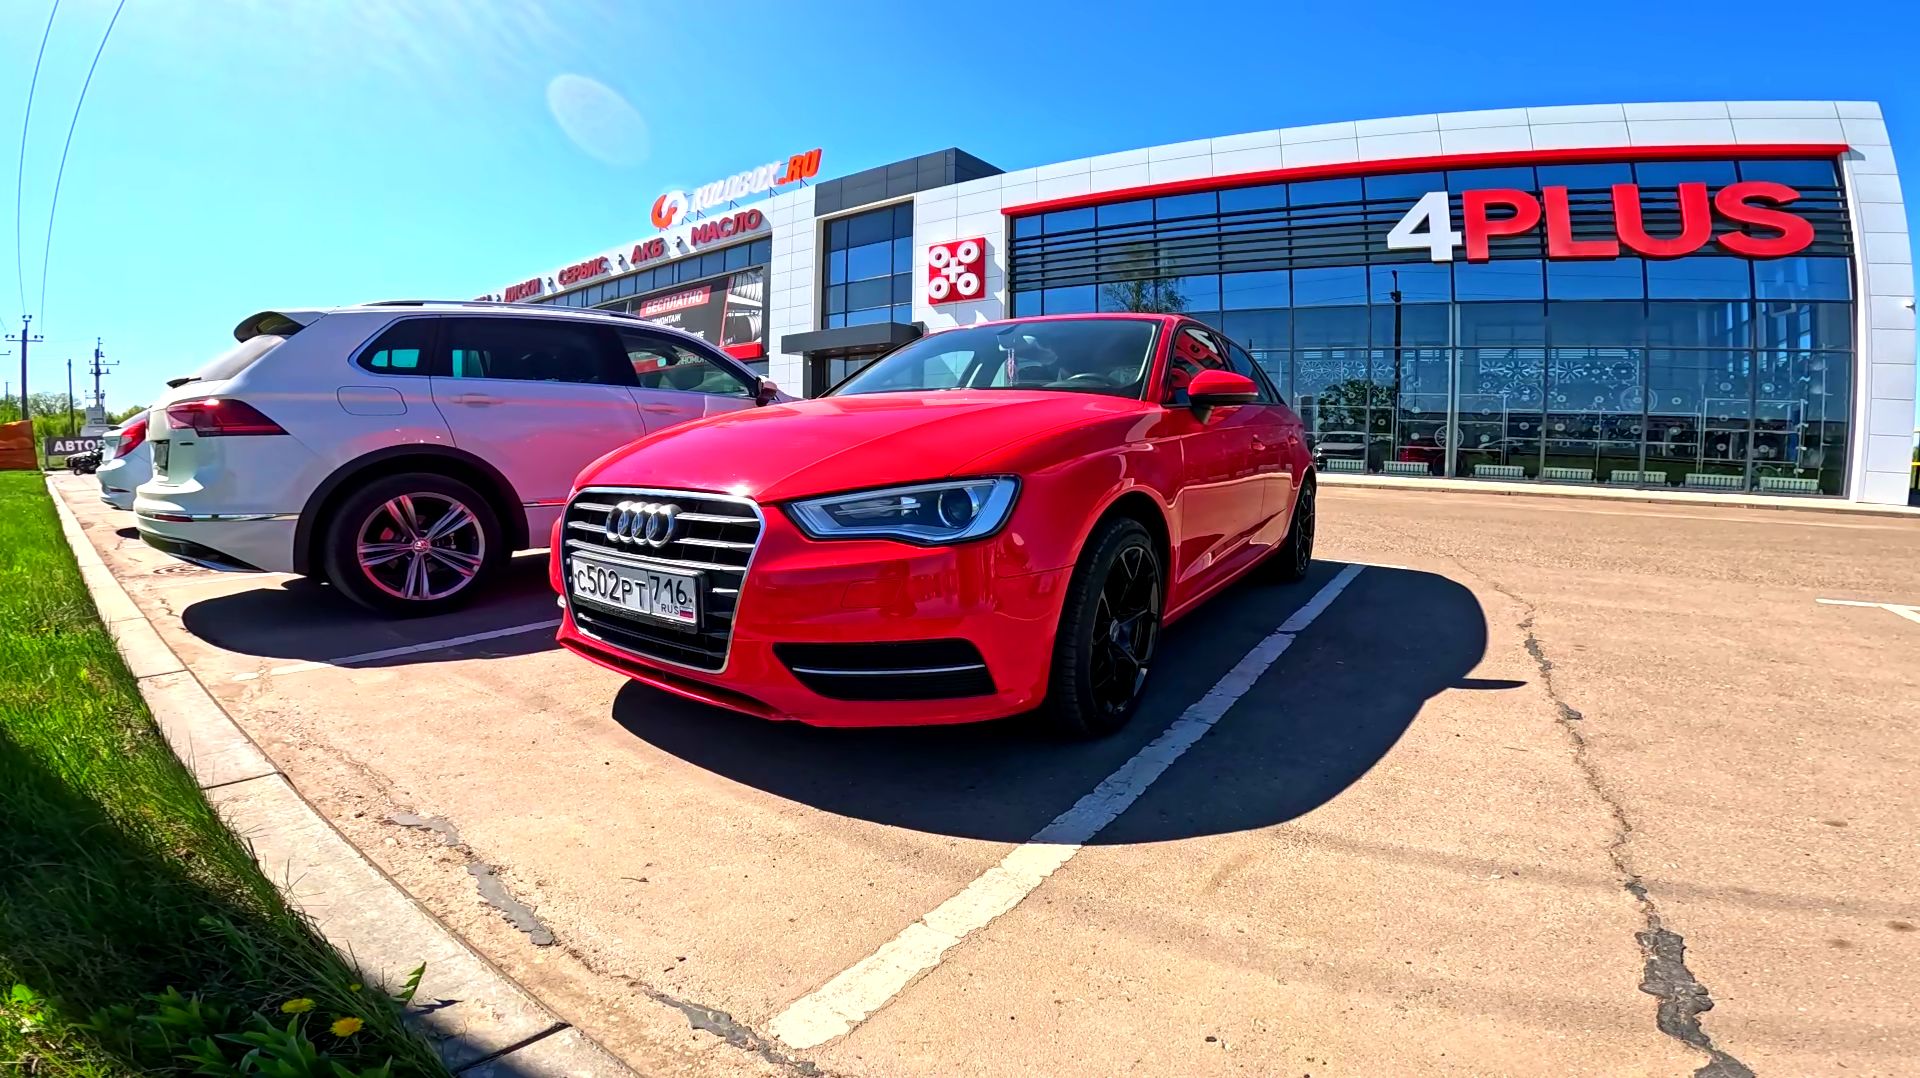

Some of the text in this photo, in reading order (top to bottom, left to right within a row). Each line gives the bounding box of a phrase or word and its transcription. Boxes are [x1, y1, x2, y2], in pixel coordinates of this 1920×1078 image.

[1386, 181, 1816, 263] 4PLUS
[558, 256, 609, 286] СЕРВИС
[631, 237, 665, 264] АКБ
[691, 209, 764, 246] МАСЛО
[645, 290, 704, 315] БЕСПЛАТНО
[650, 576, 688, 605] 716
[661, 603, 679, 614] RUS
